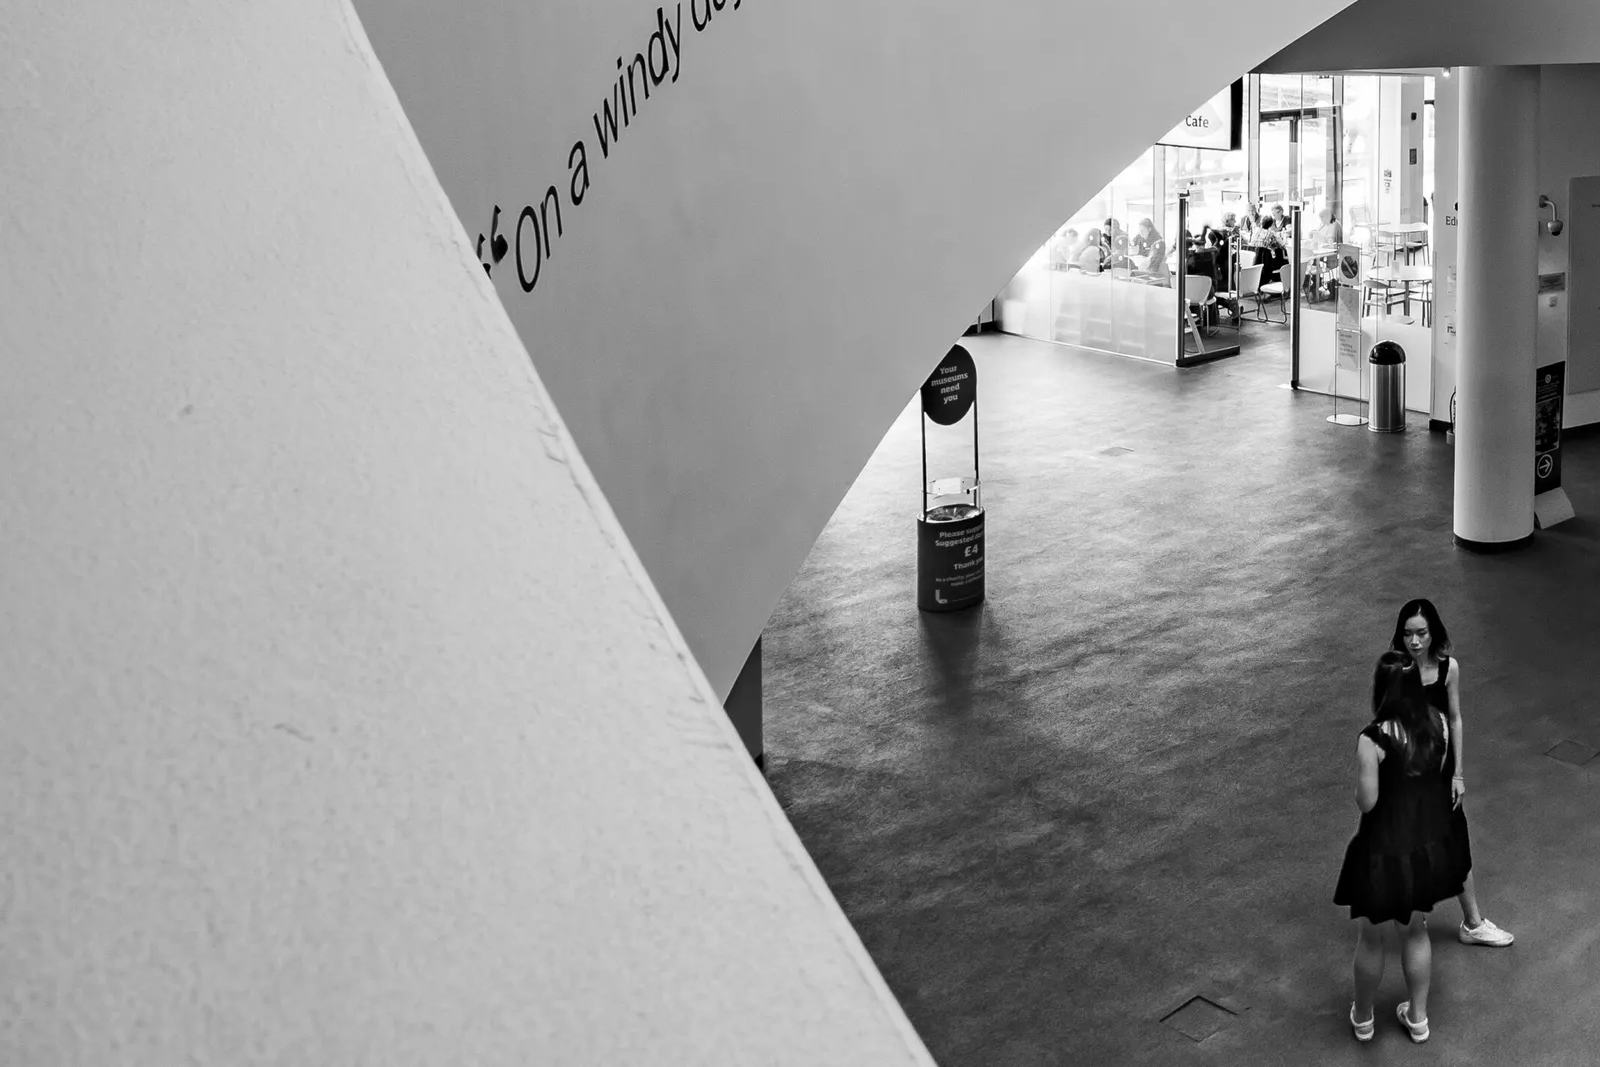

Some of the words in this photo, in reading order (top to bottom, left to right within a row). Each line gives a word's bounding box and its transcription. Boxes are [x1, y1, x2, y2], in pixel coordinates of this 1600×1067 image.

[567, 140, 591, 207] a
[592, 2, 681, 160] windy
[1186, 115, 1209, 128] Cafe
[940, 365, 957, 374] Your
[931, 373, 968, 386] museums
[941, 383, 960, 394] need
[943, 394, 958, 404] you
[940, 530, 965, 538] Please
[935, 535, 974, 548] Suggested
[964, 544, 978, 557] £4
[954, 560, 975, 570] Thank
